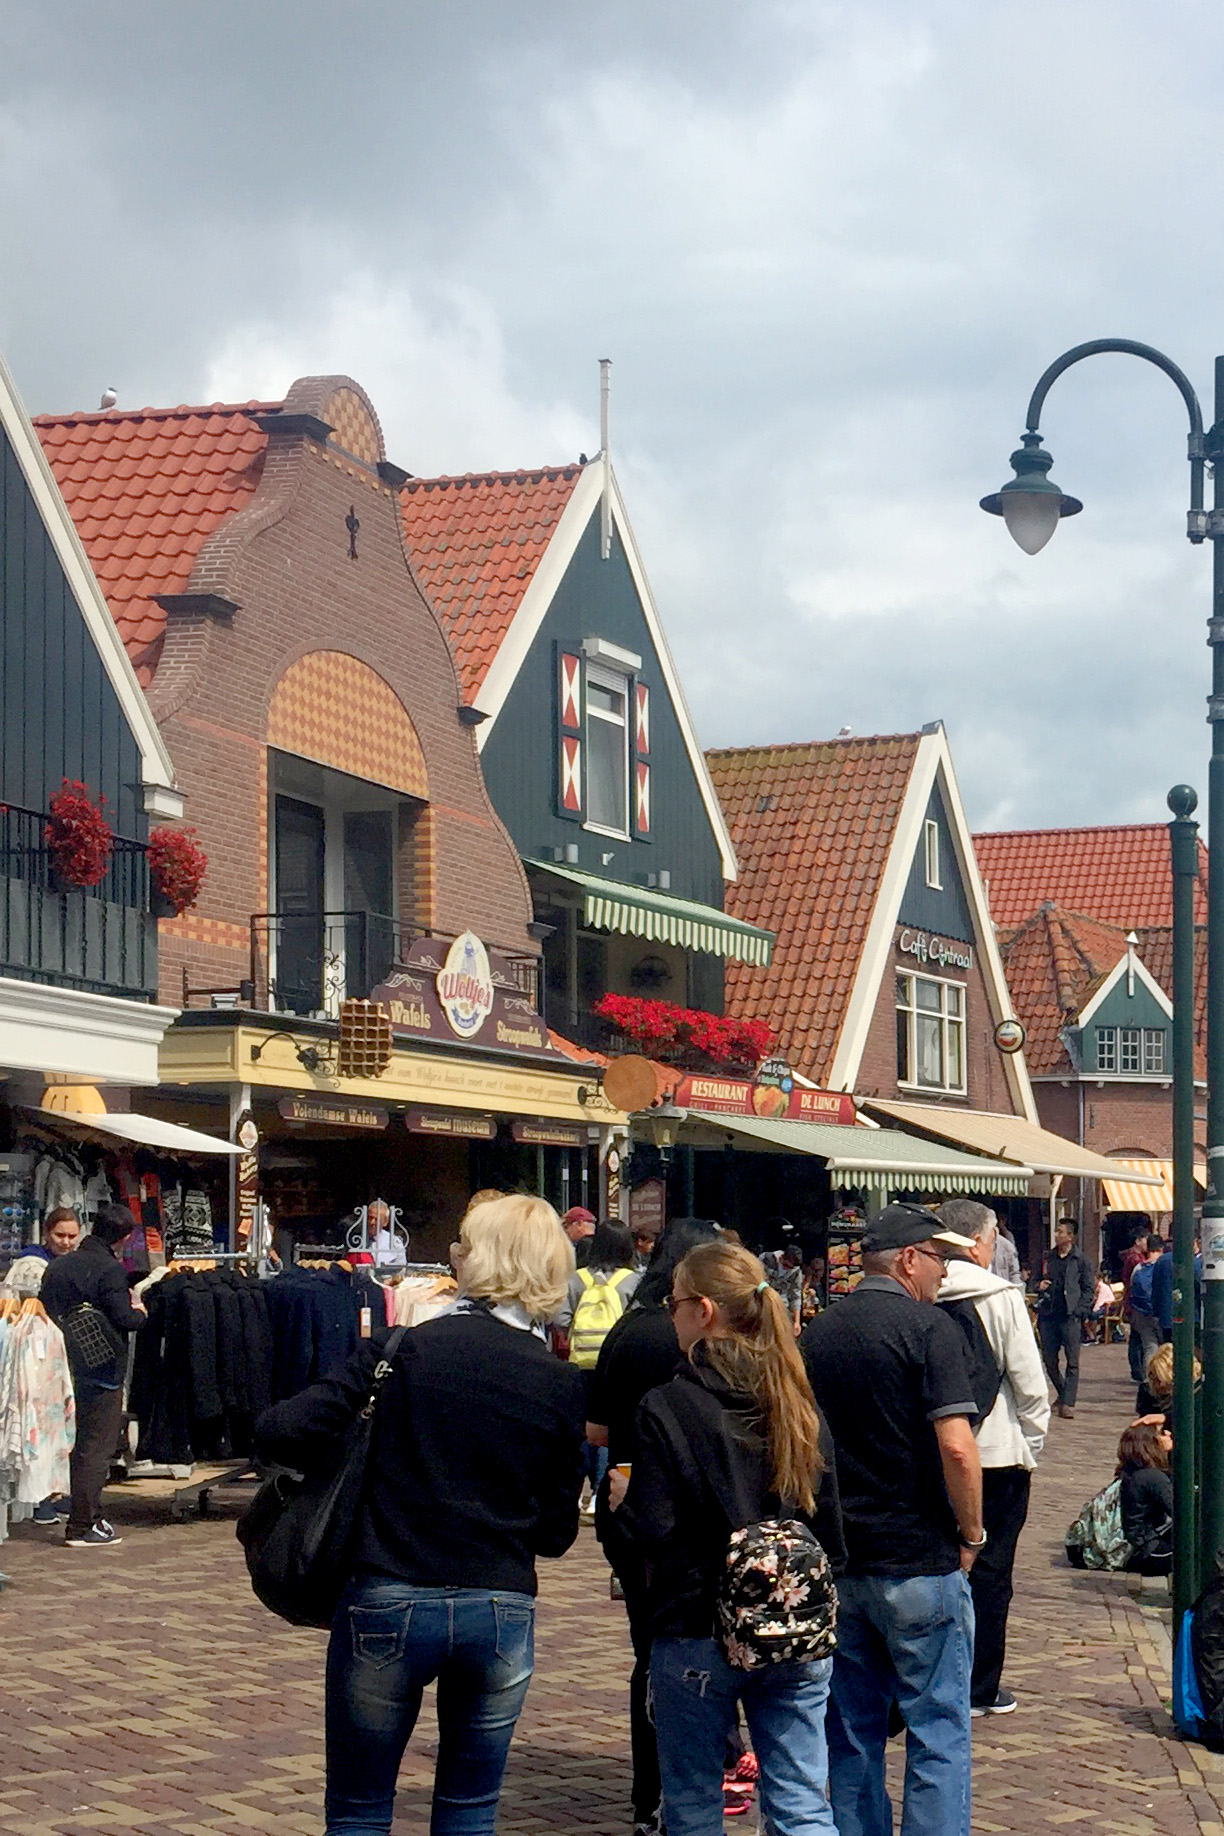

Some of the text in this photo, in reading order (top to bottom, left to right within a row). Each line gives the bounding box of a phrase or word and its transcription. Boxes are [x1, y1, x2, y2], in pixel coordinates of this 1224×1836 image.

[900, 929, 973, 969] Café Centraal
[441, 972, 491, 1010] Woltje's
[389, 1000, 432, 1030] Wafels
[690, 1079, 749, 1103] RESTAURANT
[801, 1093, 841, 1112] DE LUNCH
[293, 1101, 378, 1125] Volendamse Wafels
